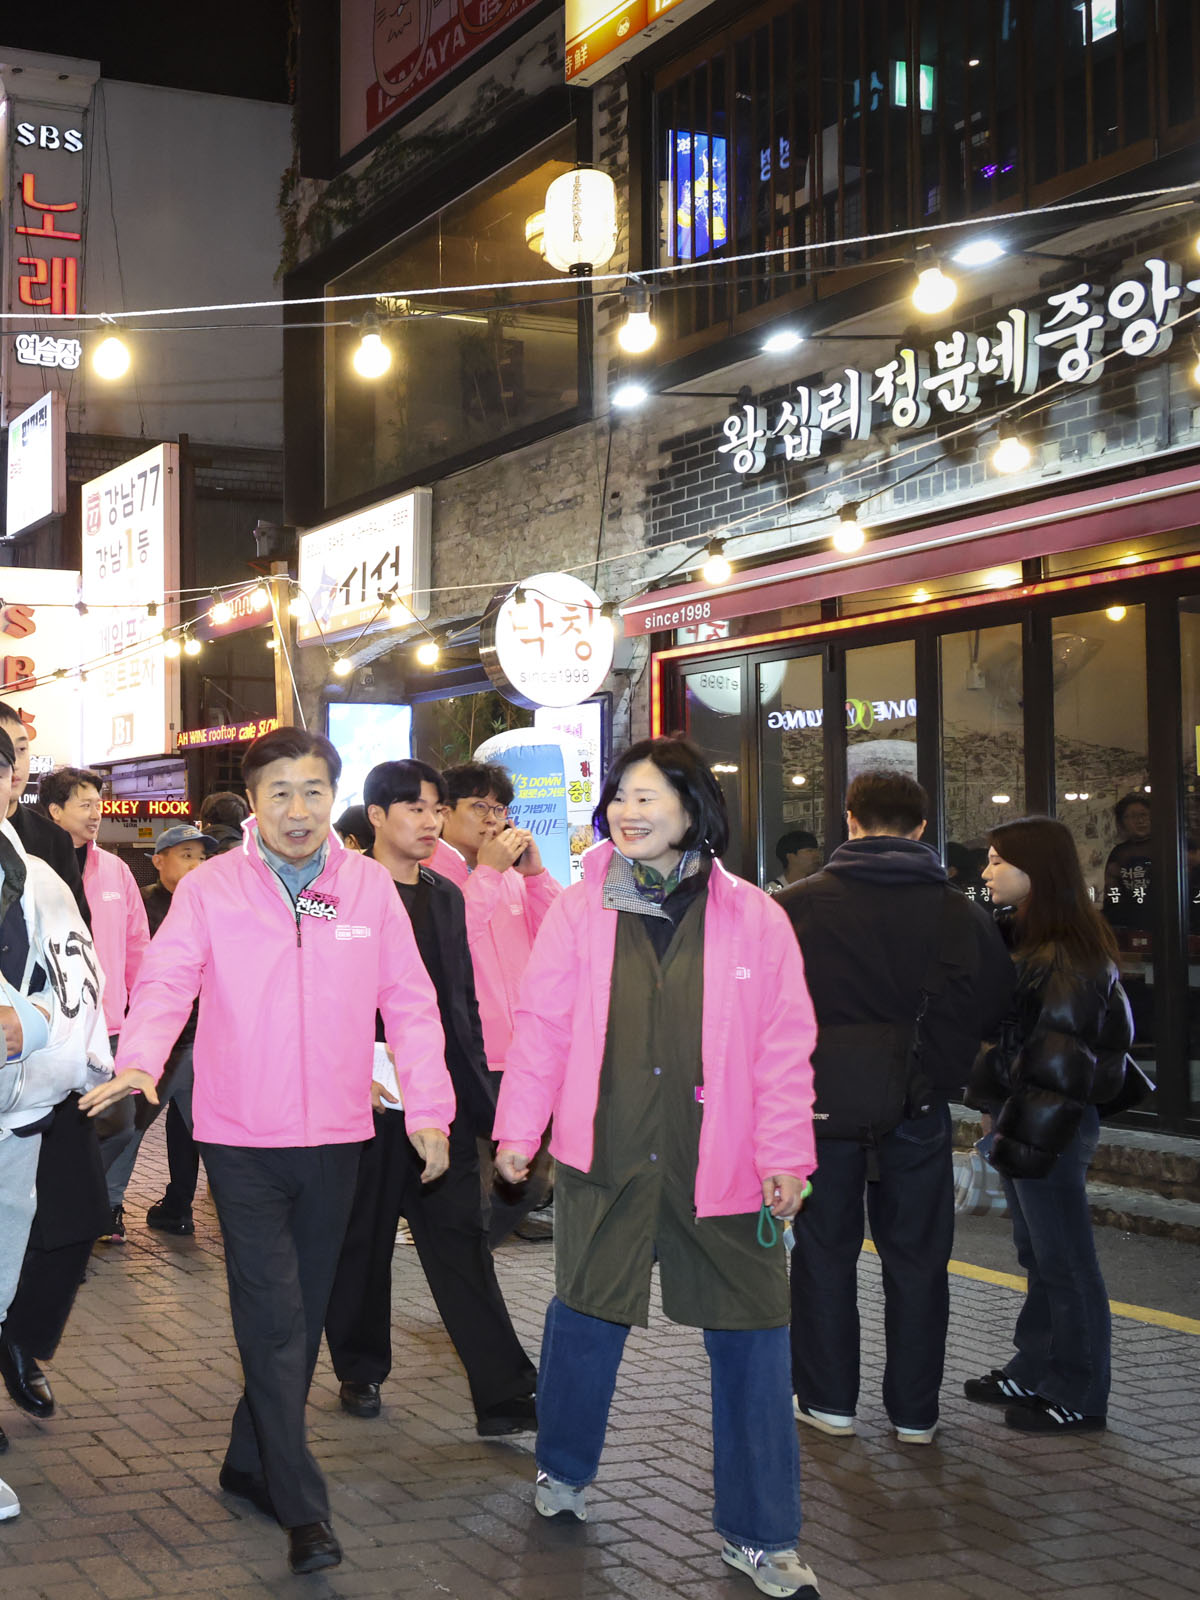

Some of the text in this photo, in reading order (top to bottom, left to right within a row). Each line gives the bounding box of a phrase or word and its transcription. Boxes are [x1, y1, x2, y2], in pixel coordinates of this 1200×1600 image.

[16, 122, 84, 153] SBS
[16, 173, 81, 320] 노래
[18, 336, 80, 368] 연습장
[104, 464, 161, 526] 강남77
[95, 528, 150, 579] 강남1등
[644, 602, 712, 630] since1998
[519, 668, 590, 684] since1998
[114, 715, 132, 745] B1
[189, 728, 208, 745] WINE
[208, 725, 237, 742] rooftop
[238, 722, 257, 741] cafe
[517, 788, 567, 799] 제로슈거로
[529, 776, 563, 788] DOWN
[148, 800, 190, 815] HOOK
[523, 803, 557, 815] 가볍게!
[1120, 865, 1146, 880] 처음
[296, 896, 338, 921] 전성수
